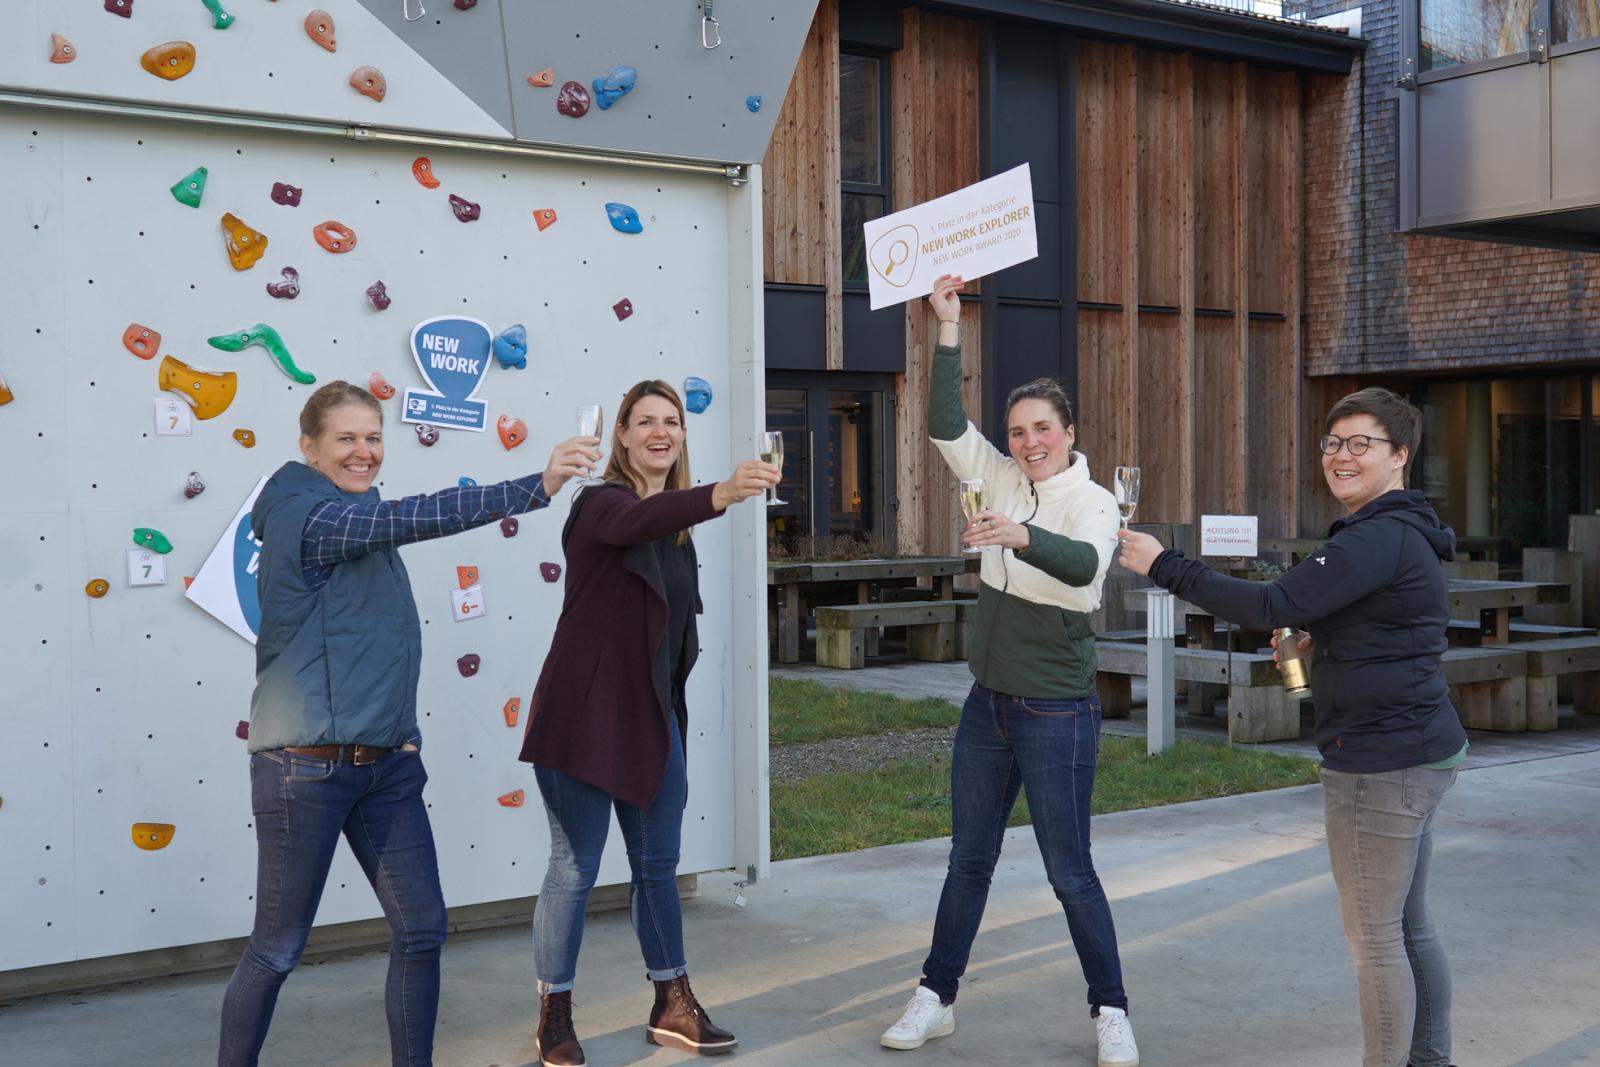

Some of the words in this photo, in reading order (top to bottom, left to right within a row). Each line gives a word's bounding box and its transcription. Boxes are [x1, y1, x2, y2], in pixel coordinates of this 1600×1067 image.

[938, 219, 955, 231] Platz
[958, 214, 964, 222] in
[966, 208, 979, 221] der
[981, 195, 1017, 214] Kategorie
[922, 239, 944, 255] NEW
[946, 226, 977, 246] WORK
[979, 206, 1031, 234] EXPLORER
[933, 253, 950, 265] NEW
[951, 245, 974, 259] WORK
[976, 234, 1002, 251] AWARD
[1004, 227, 1022, 241] 2020
[422, 333, 460, 353] NEW
[430, 352, 480, 375] WORK
[169, 416, 179, 430] 7
[142, 565, 152, 578] 7
